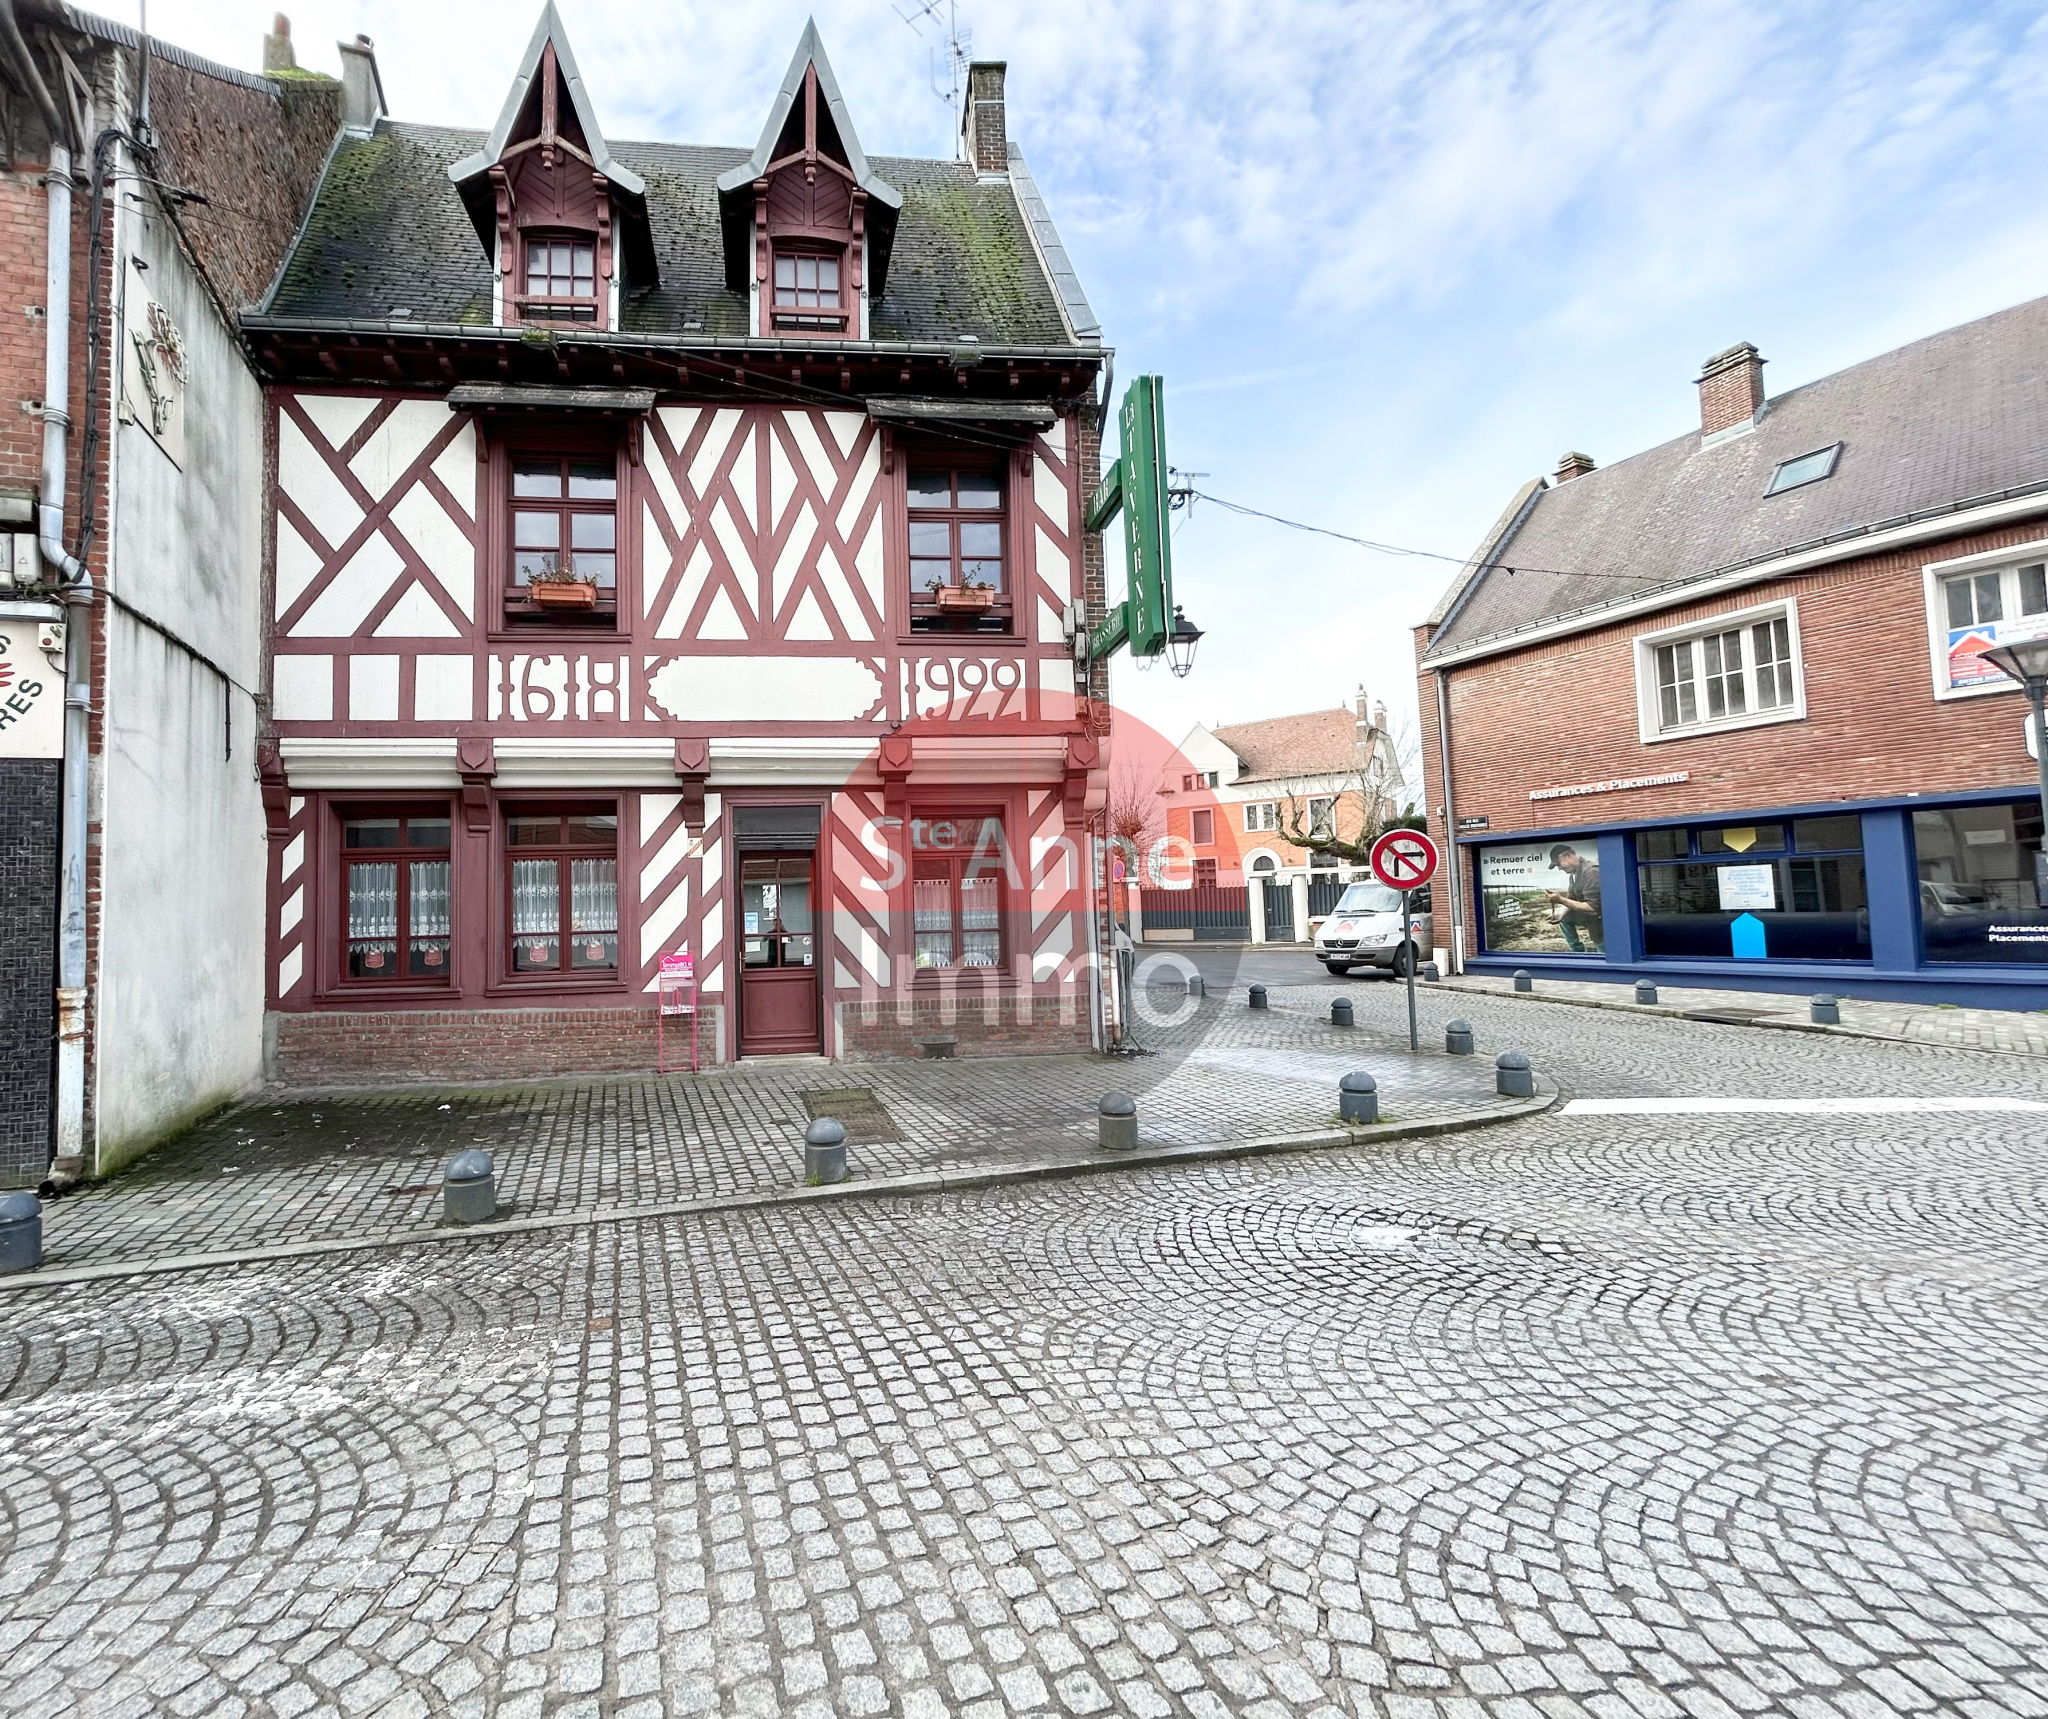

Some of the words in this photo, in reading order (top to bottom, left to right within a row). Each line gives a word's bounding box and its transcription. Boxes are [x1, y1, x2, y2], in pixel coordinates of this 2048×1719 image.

[1093, 477, 1109, 516] BAR
[1127, 426, 1145, 635] TAVERNE
[497, 653, 621, 721] 1618
[1529, 785, 1595, 800] Assurances
[1596, 781, 1607, 792] &
[1609, 772, 1688, 790] Placements
[1490, 855, 1525, 865] Remuer
[1526, 853, 1543, 863] ciel
[1490, 868, 1500, 876] et
[1502, 867, 1525, 876] terre
